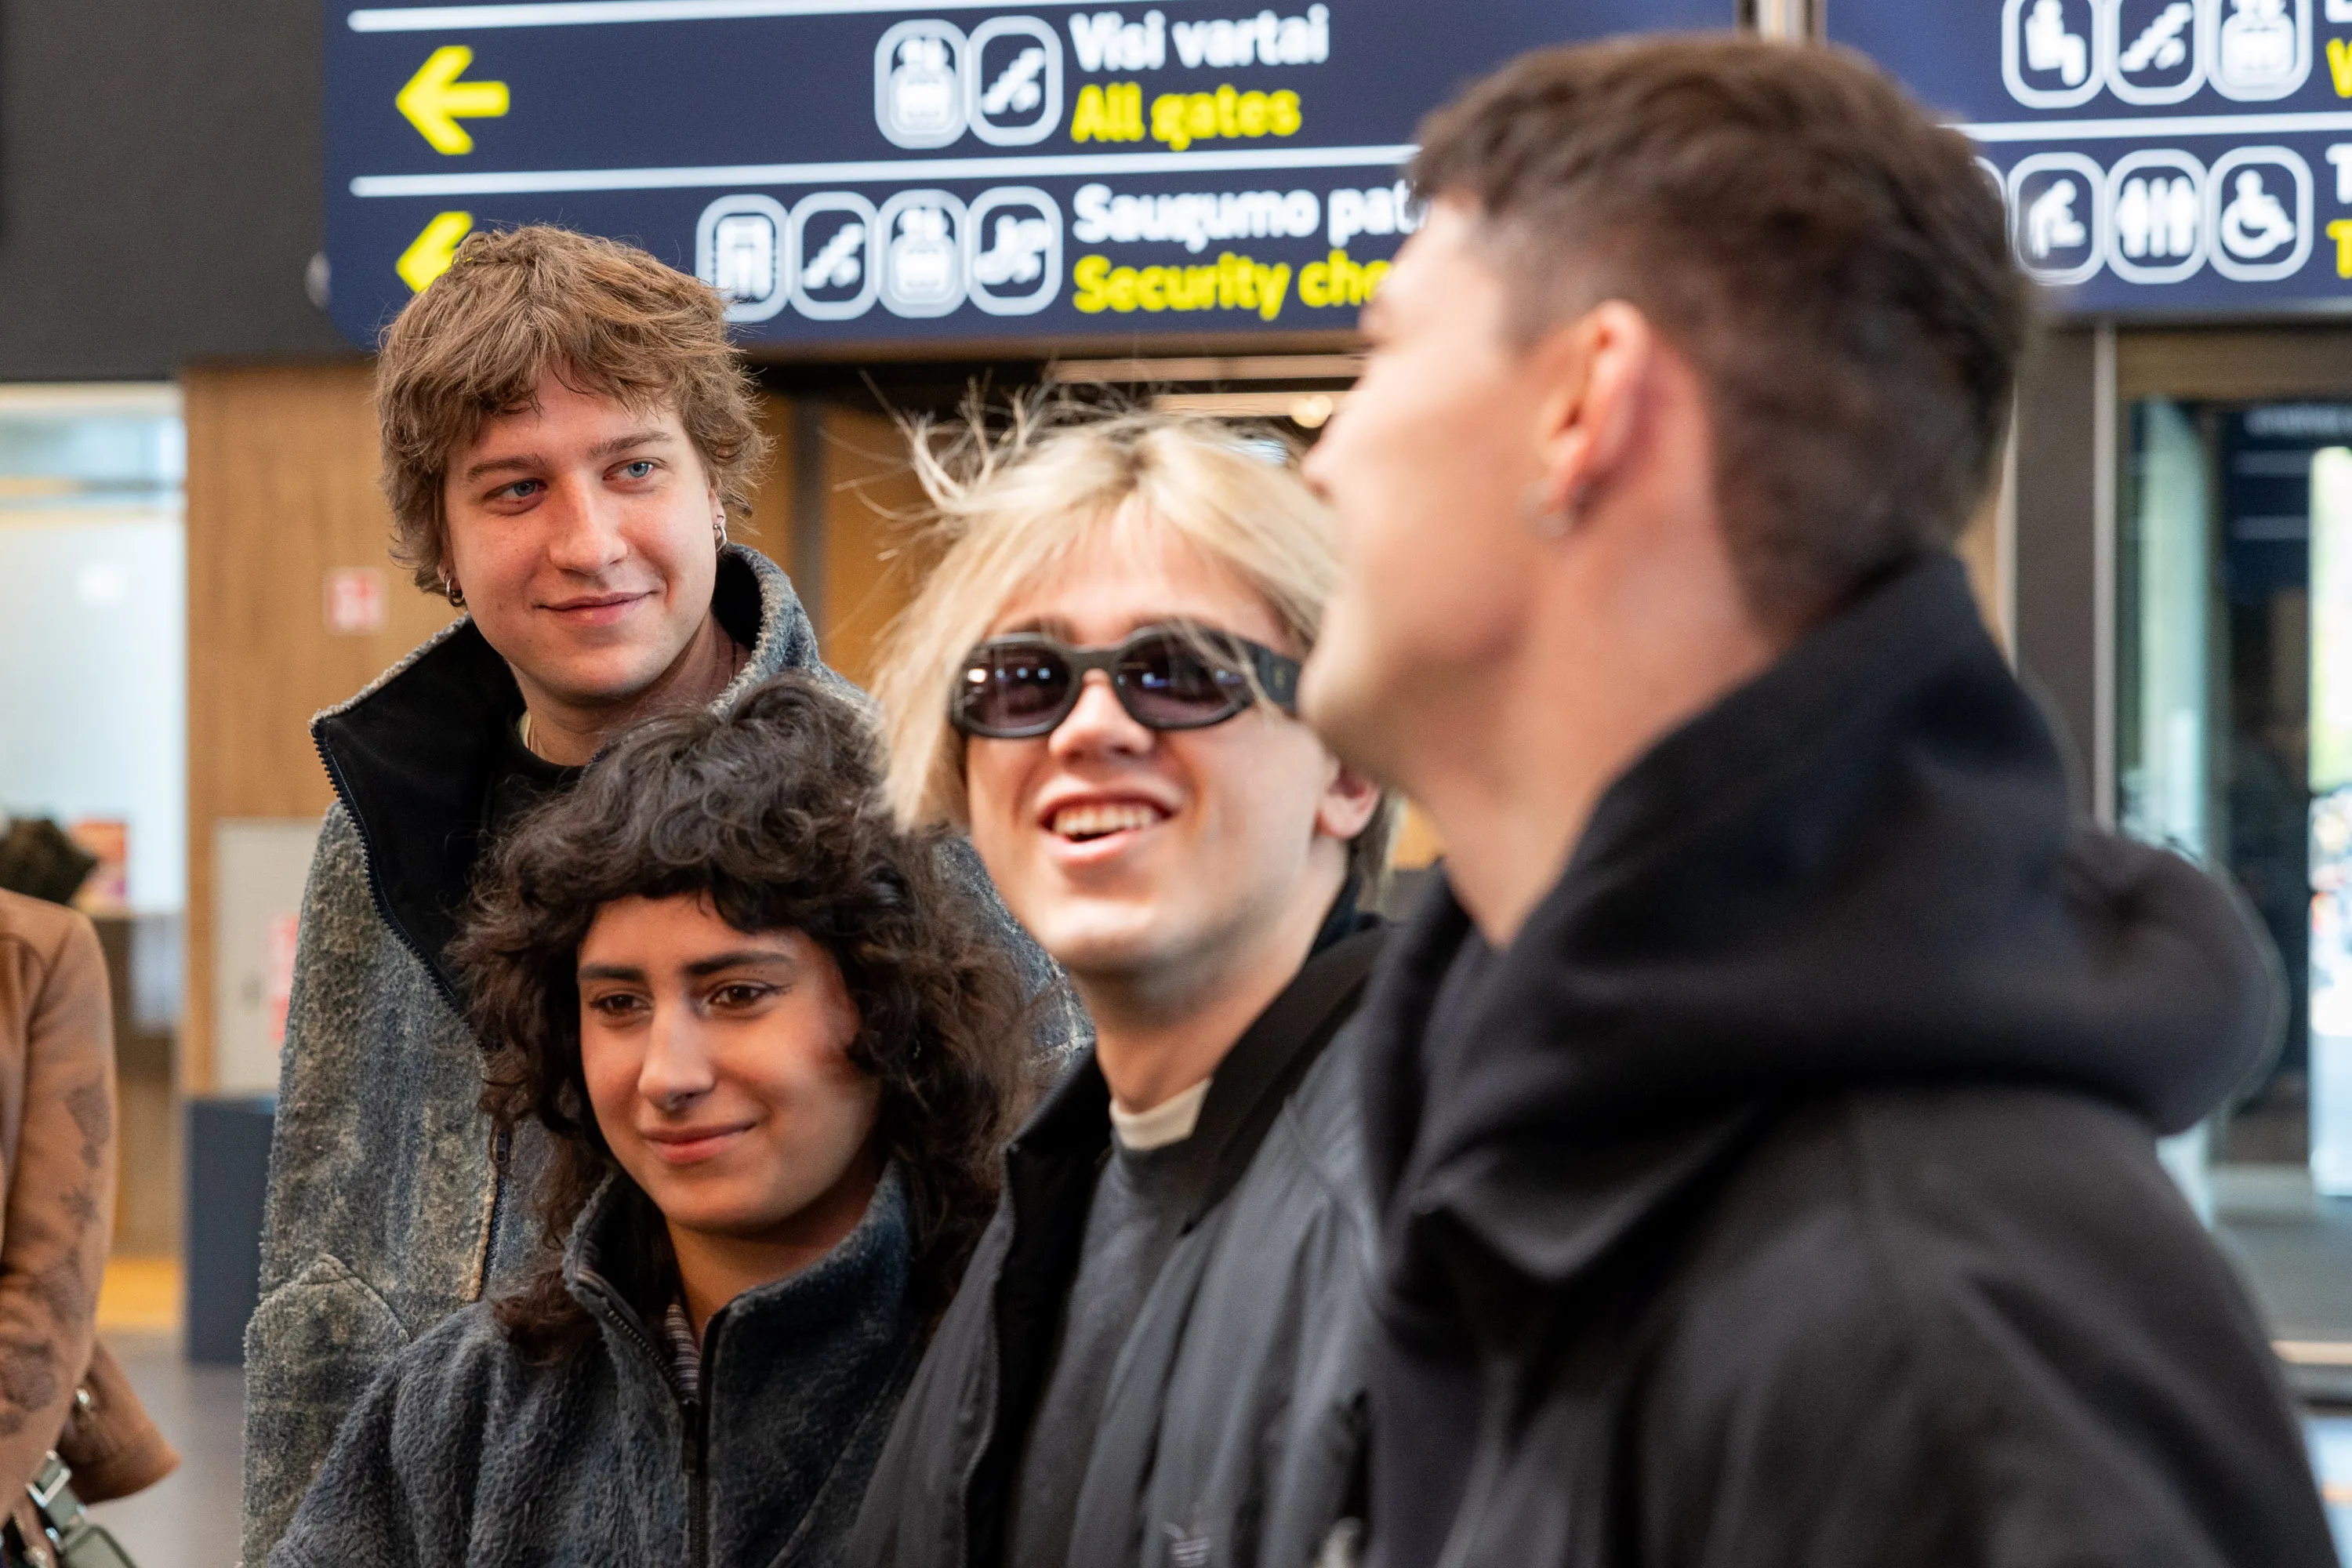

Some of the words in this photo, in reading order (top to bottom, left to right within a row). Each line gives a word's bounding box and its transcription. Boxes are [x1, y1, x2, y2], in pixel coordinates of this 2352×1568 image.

[1069, 9, 1166, 71] Visi
[1171, 3, 1330, 67] vartai
[1071, 82, 1145, 143] All
[1151, 83, 1301, 151] gates
[1073, 183, 1320, 253] Saugumo
[1073, 252, 1292, 321] Security
